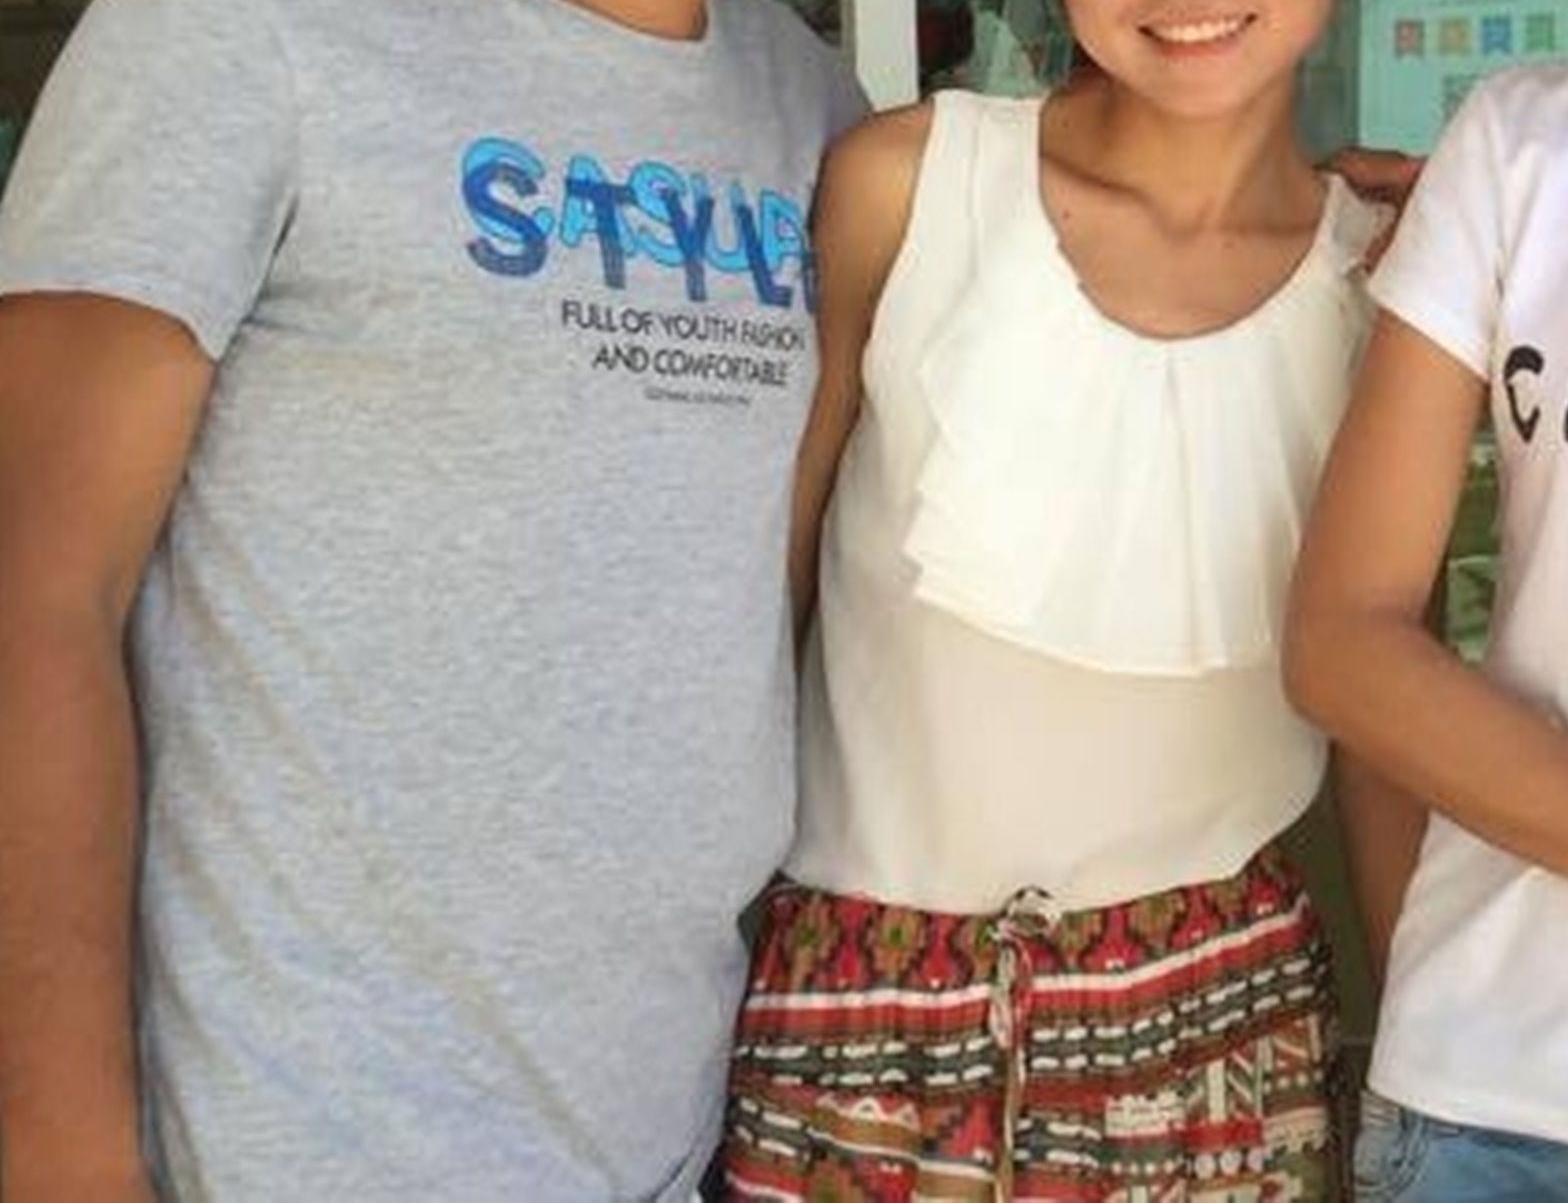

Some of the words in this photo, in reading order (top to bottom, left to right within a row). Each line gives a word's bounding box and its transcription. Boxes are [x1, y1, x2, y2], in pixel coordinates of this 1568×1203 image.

[561, 298, 618, 333] FULL
[620, 306, 656, 336] OF
[658, 313, 737, 345] YOUTH
[591, 344, 650, 373] AND
[652, 348, 789, 387] COMFORTABLE
